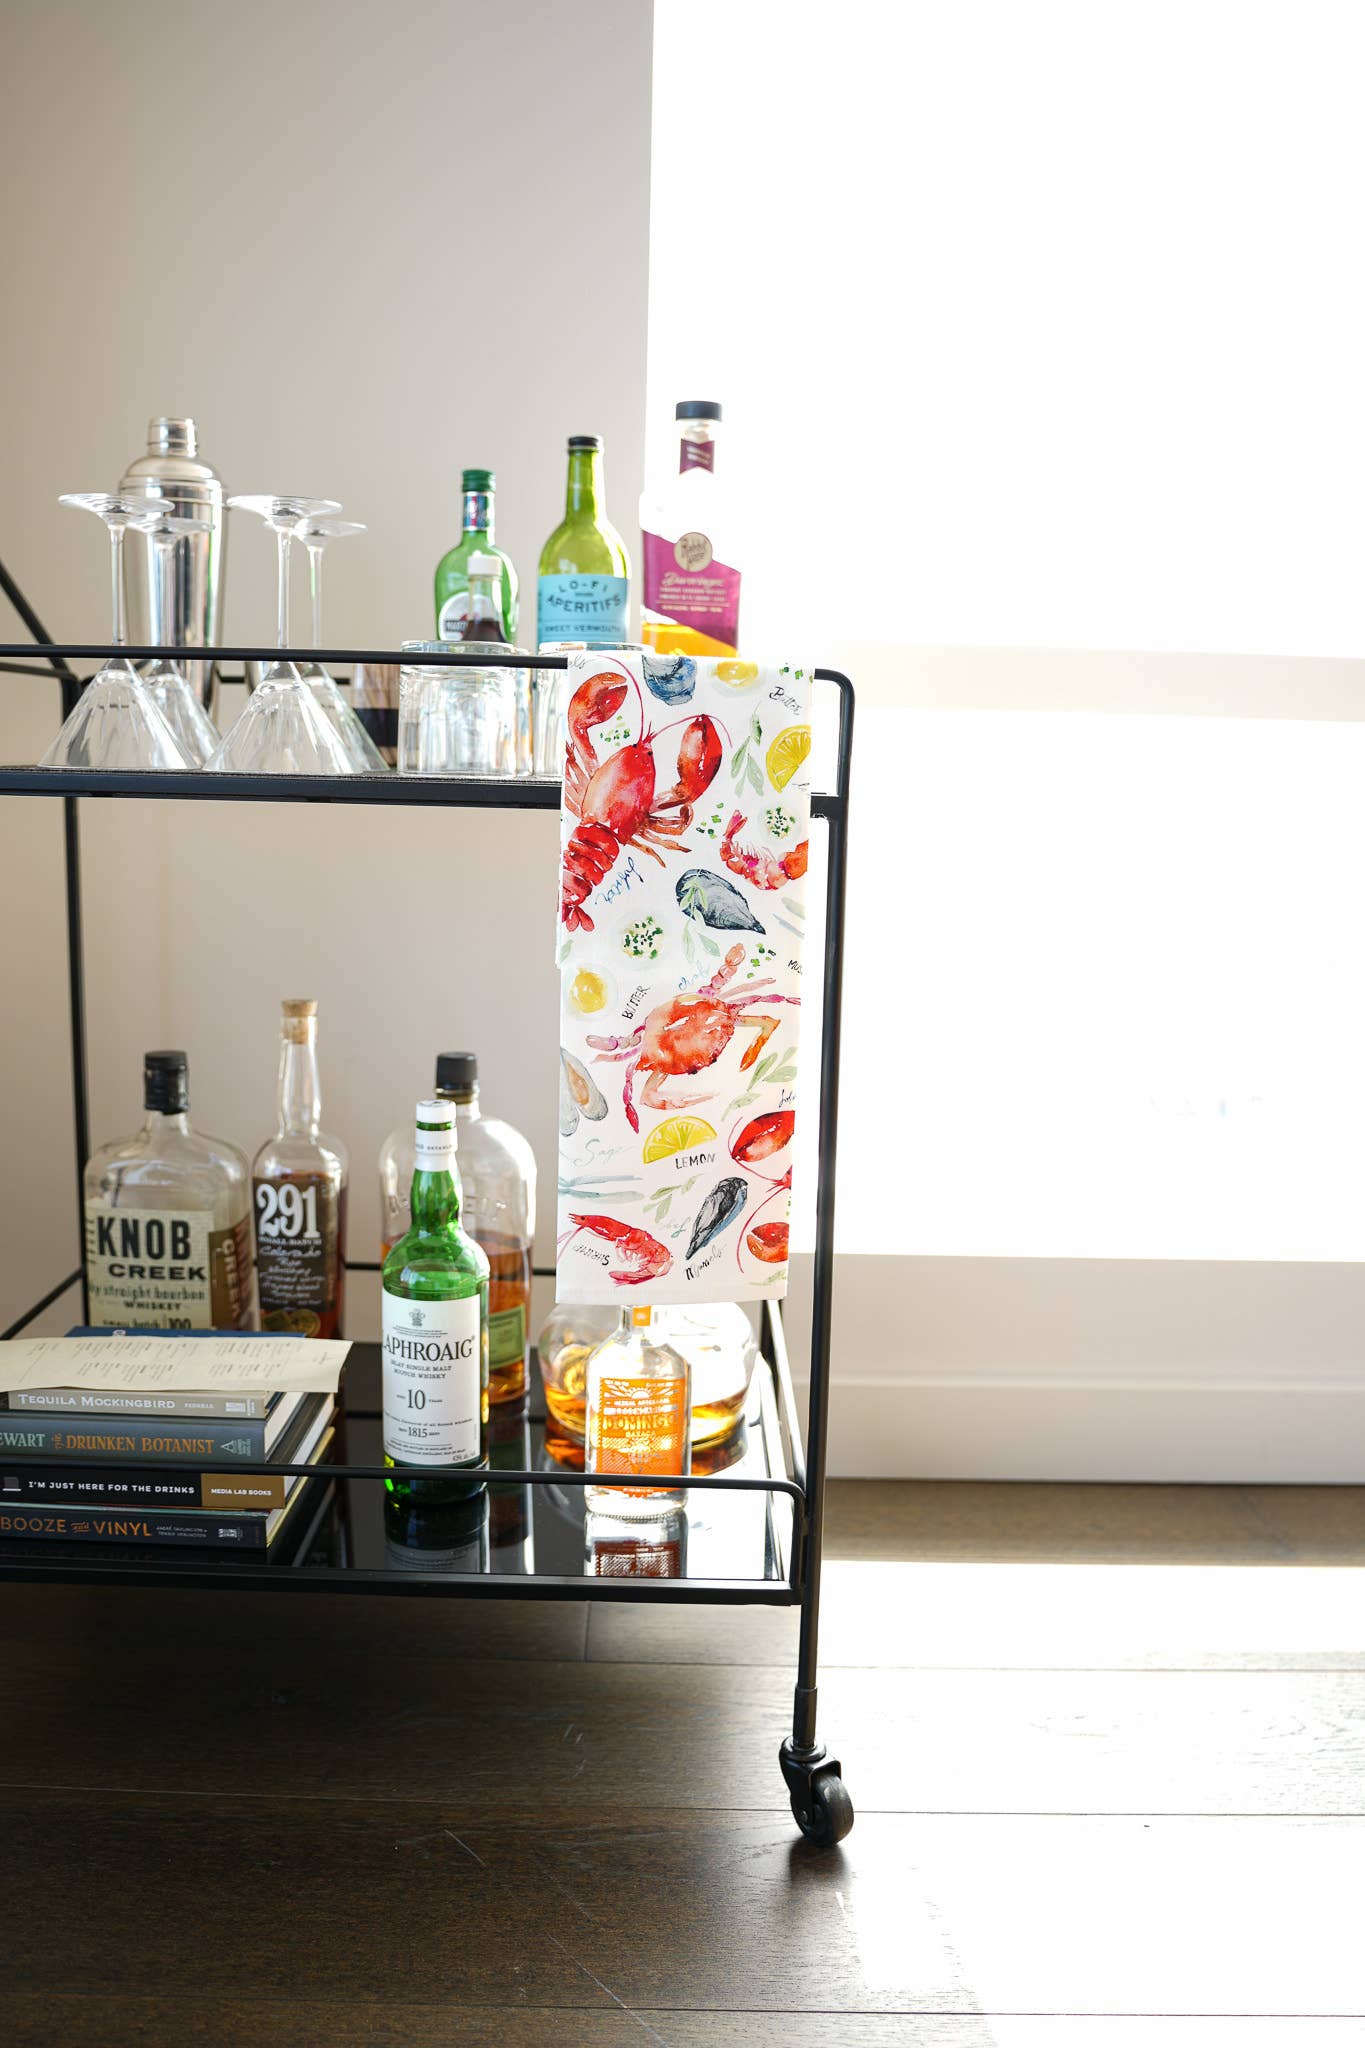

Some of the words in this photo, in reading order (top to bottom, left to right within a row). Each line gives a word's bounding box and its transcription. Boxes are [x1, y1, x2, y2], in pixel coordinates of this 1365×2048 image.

[558, 580, 608, 593] LO-FI
[547, 594, 621, 613] APERITIFS
[621, 985, 652, 1020] BUTTER
[675, 1153, 716, 1170] LEMON
[256, 1183, 321, 1238] 291
[97, 1215, 192, 1261] KNOB
[108, 1263, 207, 1281] CREEK
[383, 1334, 473, 1362] APHROAIG
[18, 1394, 77, 1406] TEQUILA
[81, 1396, 176, 1409] MOCKINGBIRD
[407, 1389, 426, 1410] 10
[407, 1426, 428, 1438] 1815
[66, 1434, 136, 1451] DRUNKEN
[142, 1436, 215, 1454] BOTANIST
[28, 1481, 46, 1489] I'M
[49, 1482, 75, 1490] JUST
[78, 1483, 105, 1491] HERE
[108, 1484, 129, 1492] FOR
[132, 1485, 151, 1493] THE
[154, 1486, 195, 1494] DRINKS
[1, 1516, 67, 1534] BOOZE
[93, 1520, 152, 1537] VINYL
